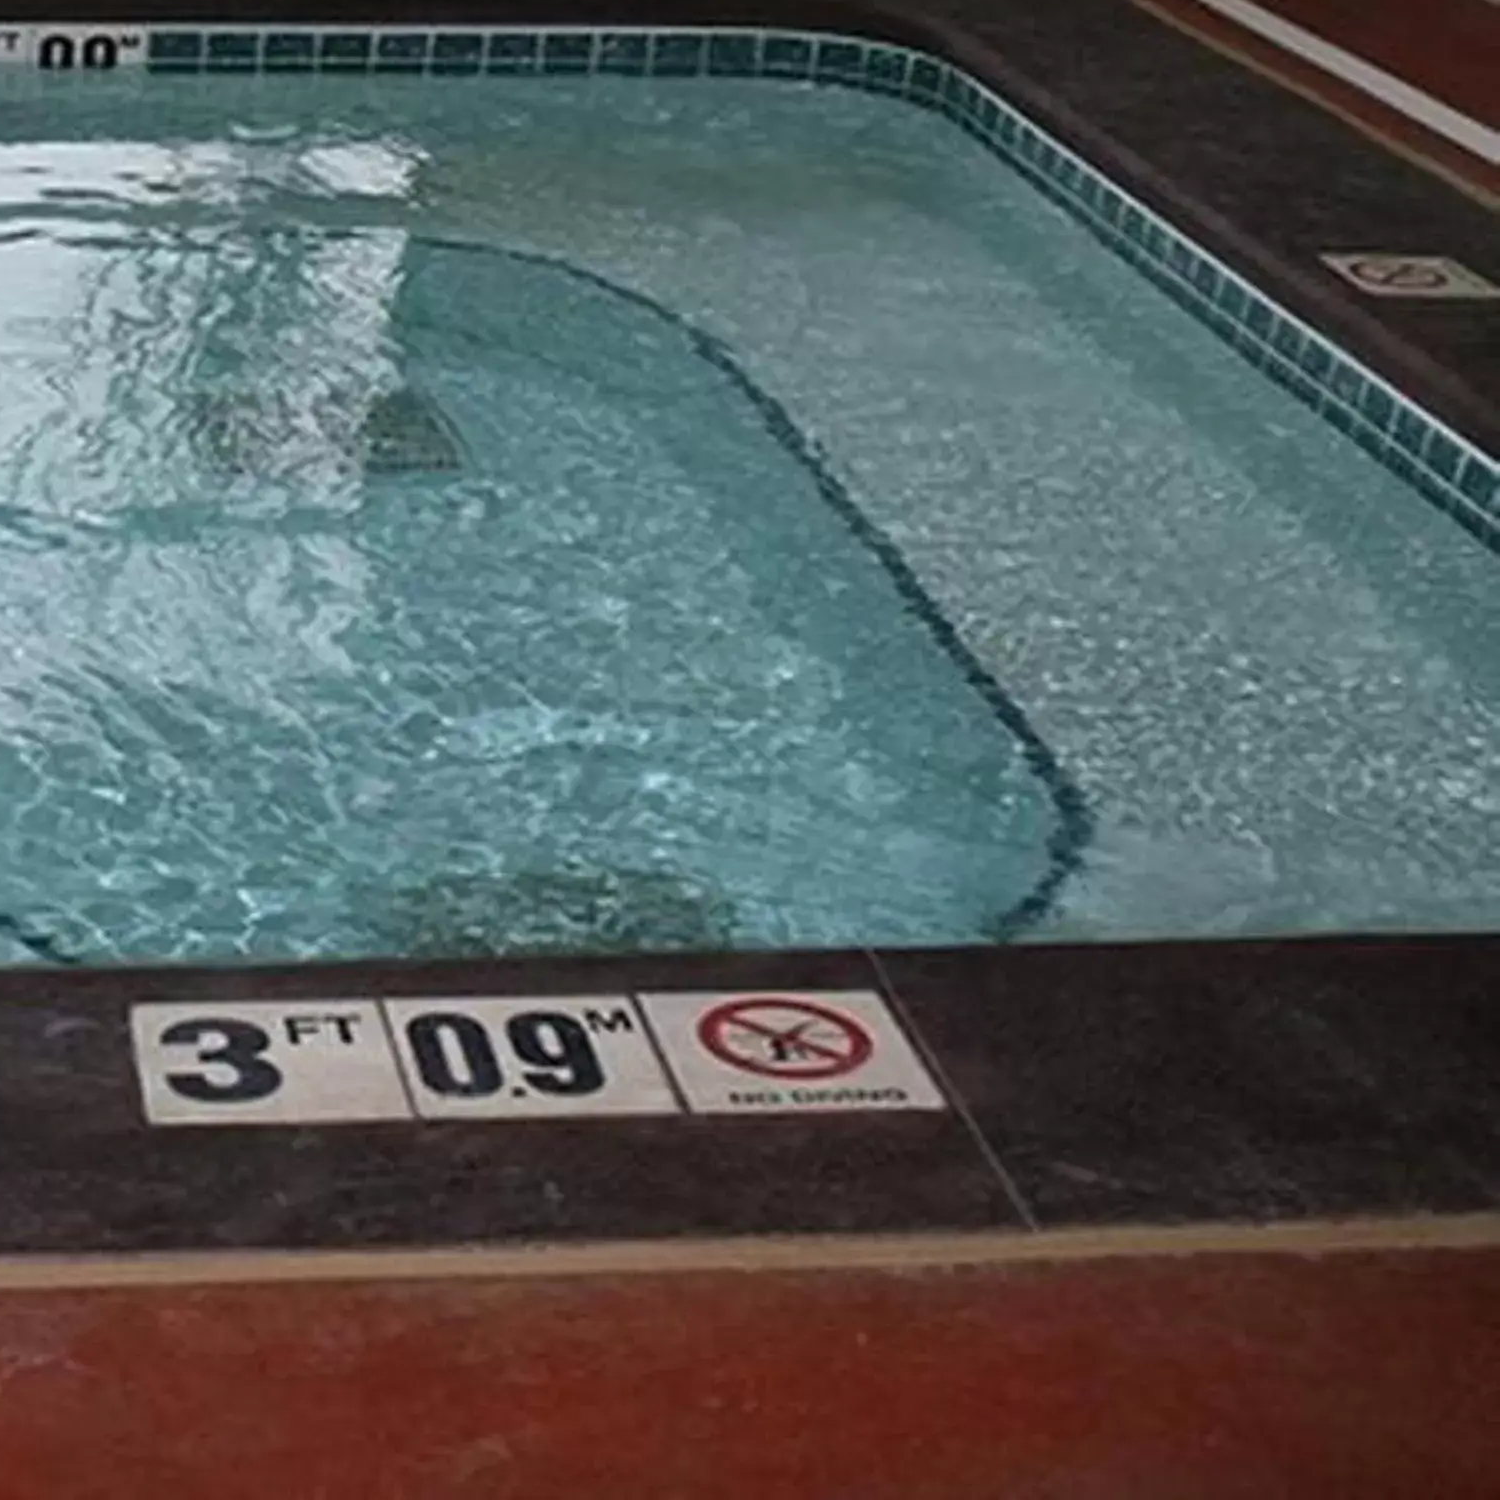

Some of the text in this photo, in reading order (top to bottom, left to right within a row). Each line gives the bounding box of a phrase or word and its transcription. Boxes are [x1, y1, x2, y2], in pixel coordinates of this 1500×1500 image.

[159, 1008, 633, 1104] 3 FT 0.9 M
